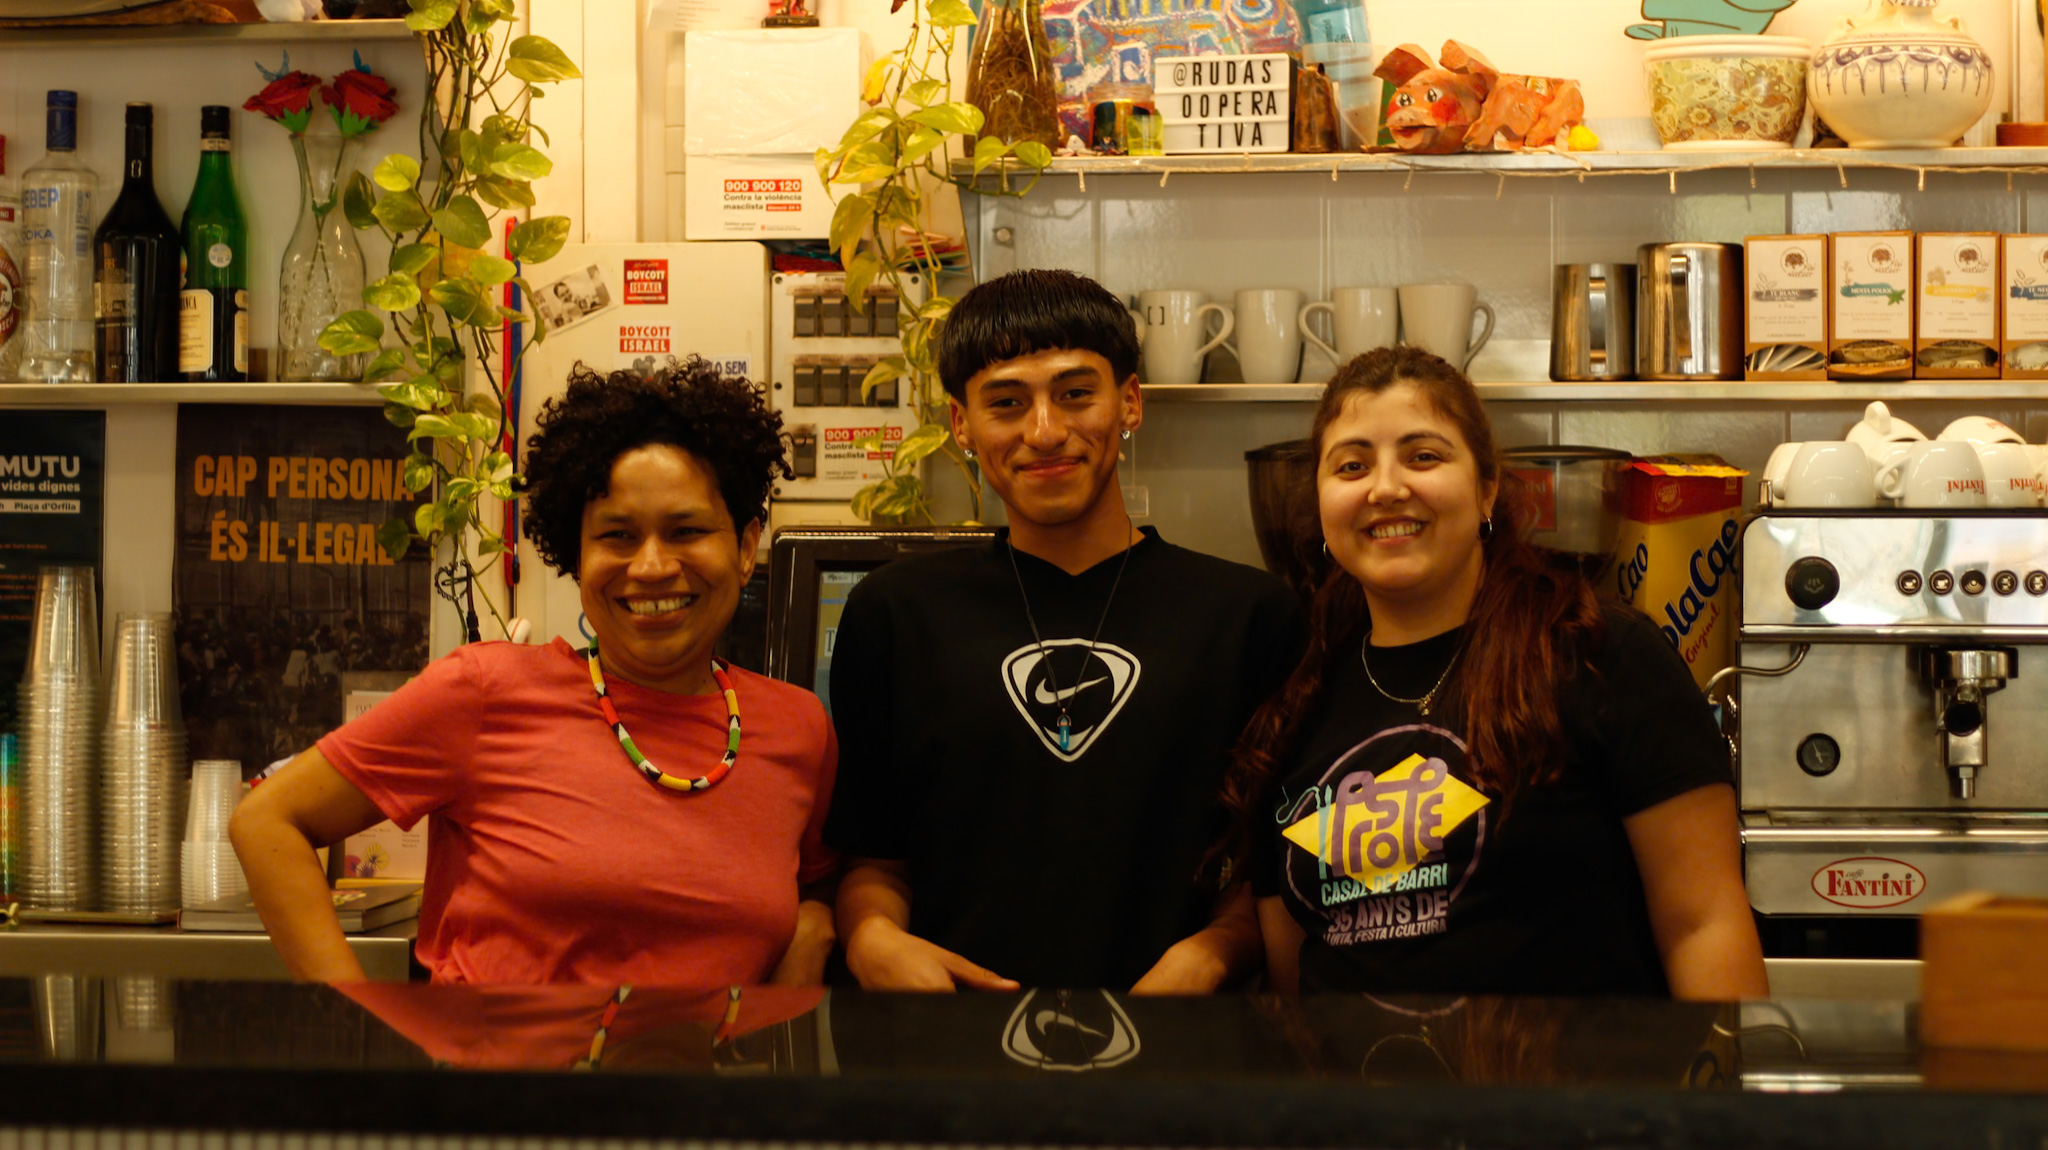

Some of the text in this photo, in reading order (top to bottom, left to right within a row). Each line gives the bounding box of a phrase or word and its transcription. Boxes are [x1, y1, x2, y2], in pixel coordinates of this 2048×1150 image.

[1172, 59, 1272, 87] @RUDAS
[1197, 121, 1263, 148] TIVA
[725, 180, 801, 192] 900 900 120
[724, 193, 752, 201] Contra
[754, 193, 762, 201] la
[626, 270, 666, 281] BOYCOTT
[629, 281, 662, 294] ISRAEL
[619, 325, 671, 337] BOYCOTT
[623, 339, 668, 352] ISRAEL
[826, 430, 850, 440] 900
[0, 455, 80, 478] MUTU
[2, 479, 80, 494] vides dignes
[194, 454, 415, 501] CAP PERSONA
[14, 502, 39, 512] Plaça
[41, 502, 76, 511] d'Orfila
[210, 509, 248, 562] ÉS
[1684, 603, 1720, 664] Original
[1320, 863, 1448, 907] CASAL DE BARRI
[1327, 890, 1449, 934] 35 ANYS DE
[1354, 926, 1388, 943] FESTA
[1394, 917, 1448, 938] CULTURA
